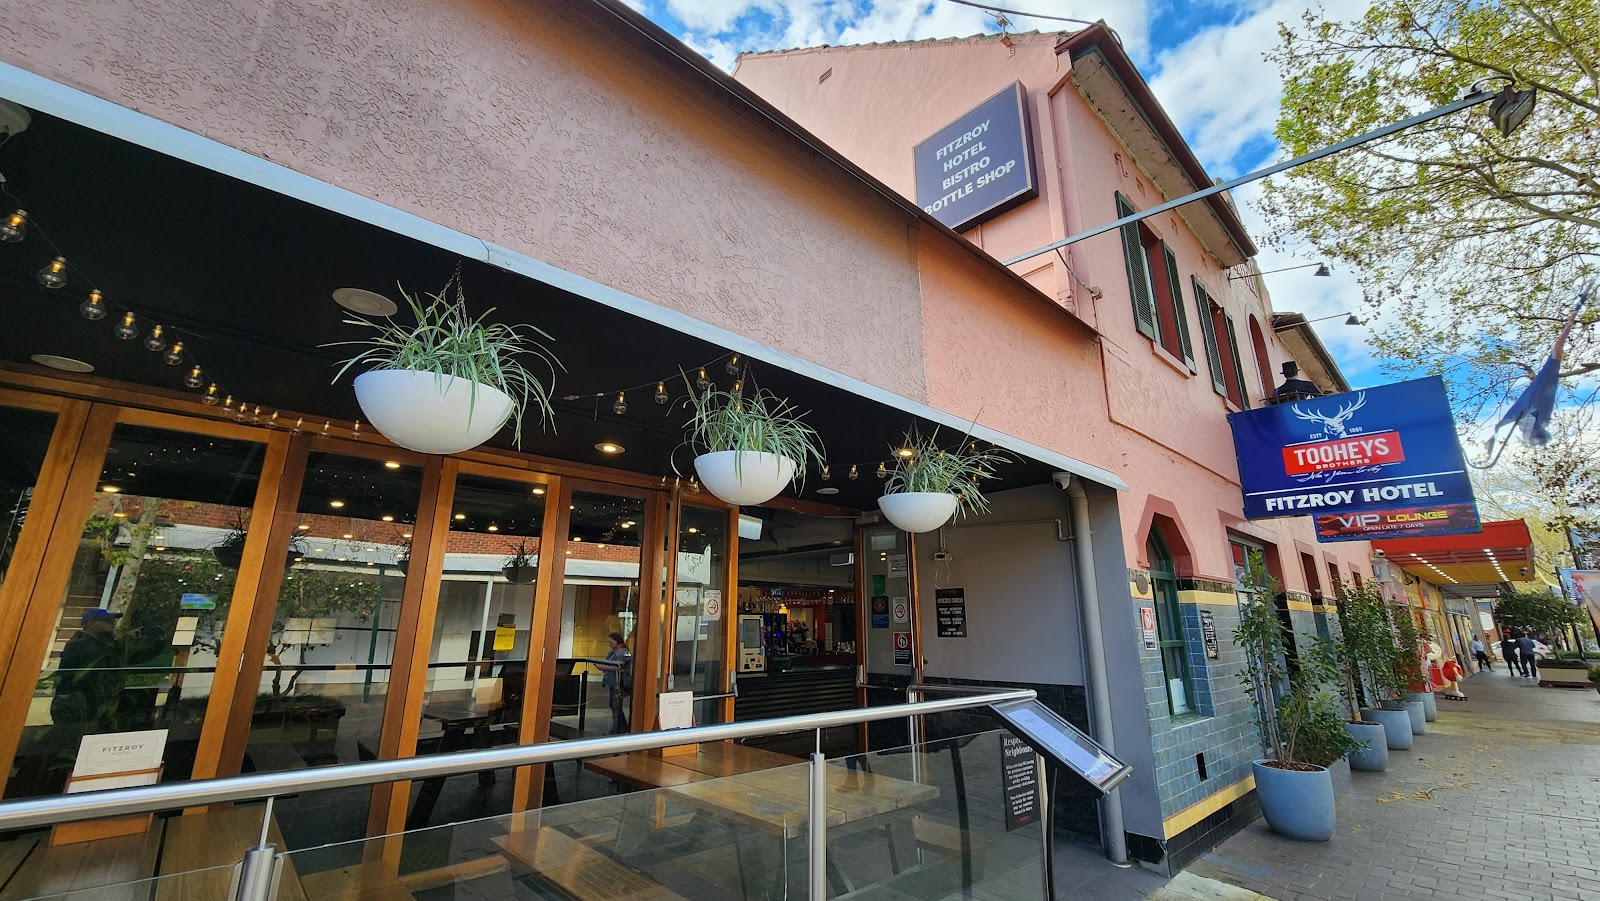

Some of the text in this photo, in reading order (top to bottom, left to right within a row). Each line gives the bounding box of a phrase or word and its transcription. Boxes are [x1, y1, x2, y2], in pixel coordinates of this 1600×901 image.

[936, 119, 990, 160] FITZROY
[943, 141, 986, 173] HOTEL
[923, 159, 1016, 215] BOTTLE SHOP
[942, 156, 991, 190] BISTRO
[1293, 438, 1390, 466] TOOHEYS
[1315, 458, 1370, 470] BROTHERS
[1265, 481, 1443, 512] FITZROY HOTEL
[1337, 510, 1448, 528] VIP LOUNGE
[102, 744, 144, 752] FITZROY
